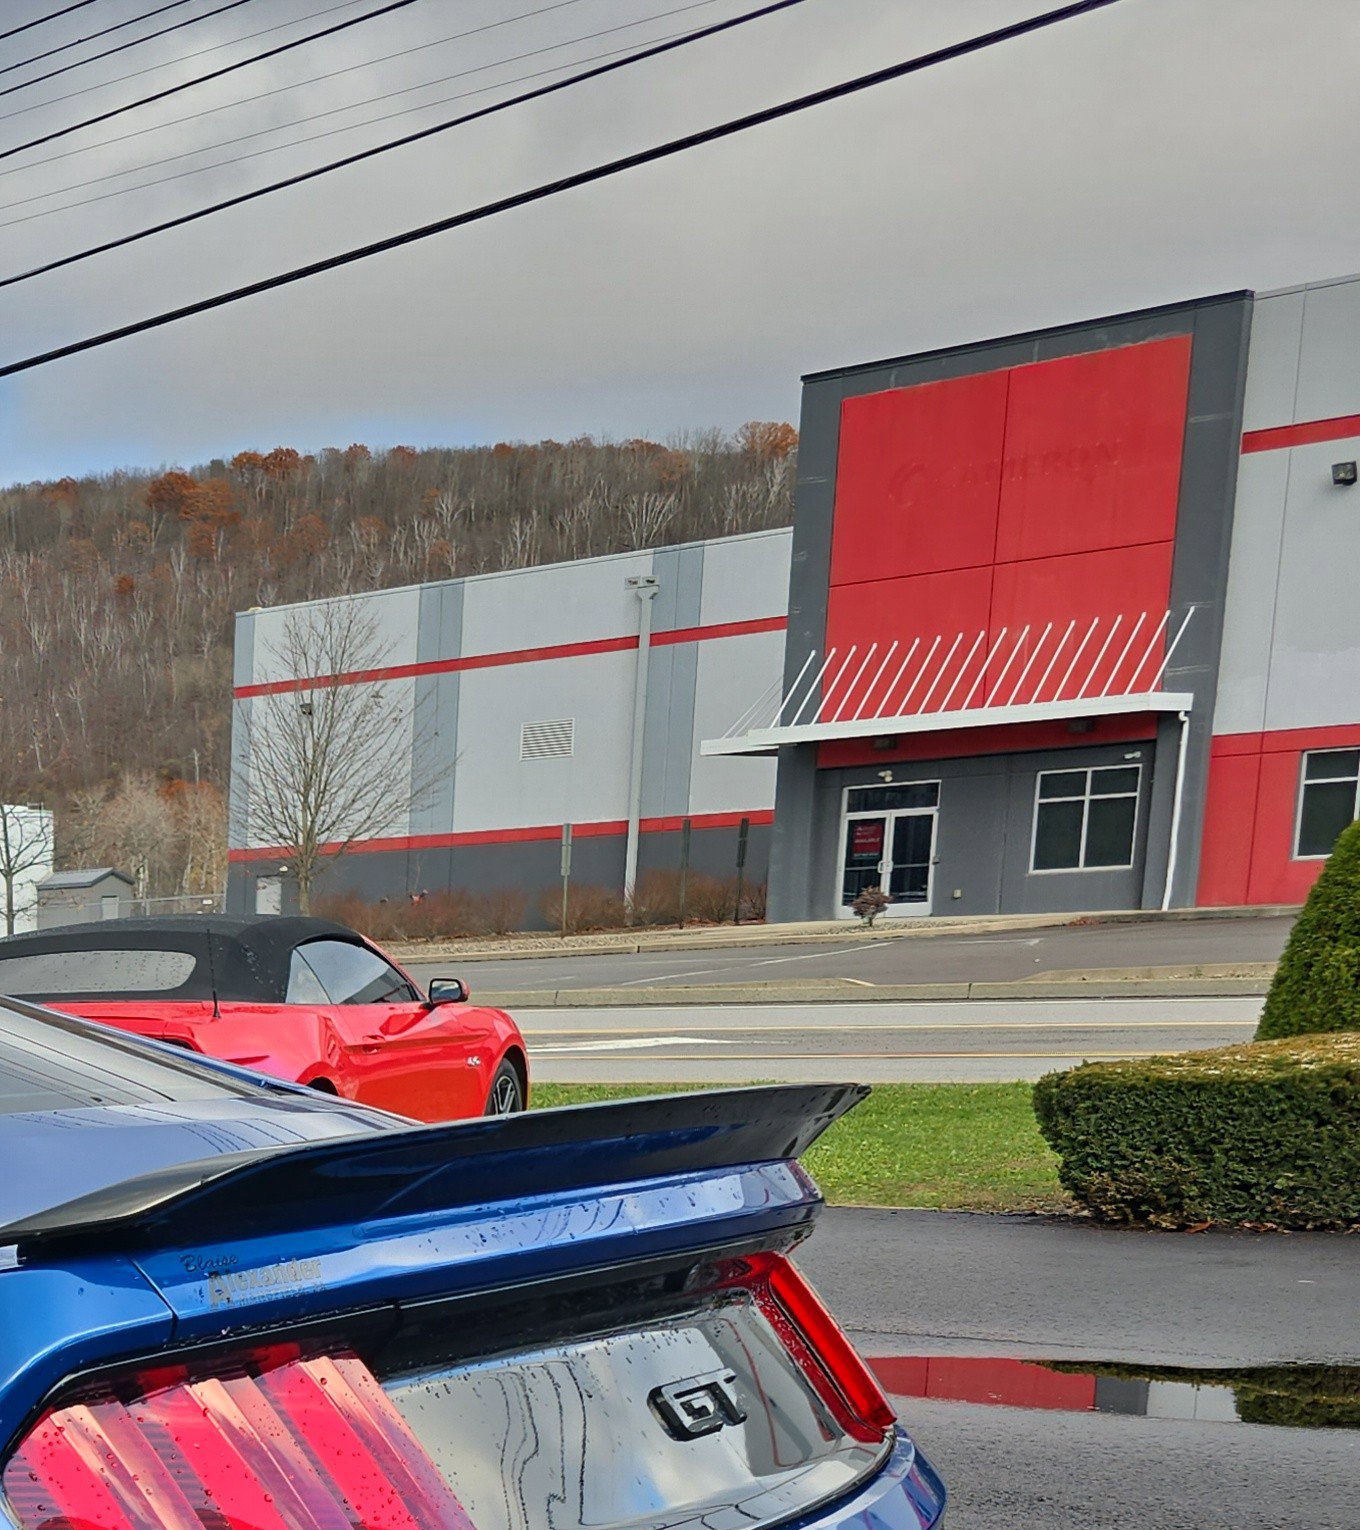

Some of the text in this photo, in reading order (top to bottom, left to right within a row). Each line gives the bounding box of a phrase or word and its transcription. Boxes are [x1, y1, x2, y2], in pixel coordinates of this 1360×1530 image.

[181, 1254, 238, 1273] Blaise
[208, 1258, 322, 1306] Alexander
[647, 1368, 747, 1442] GT
